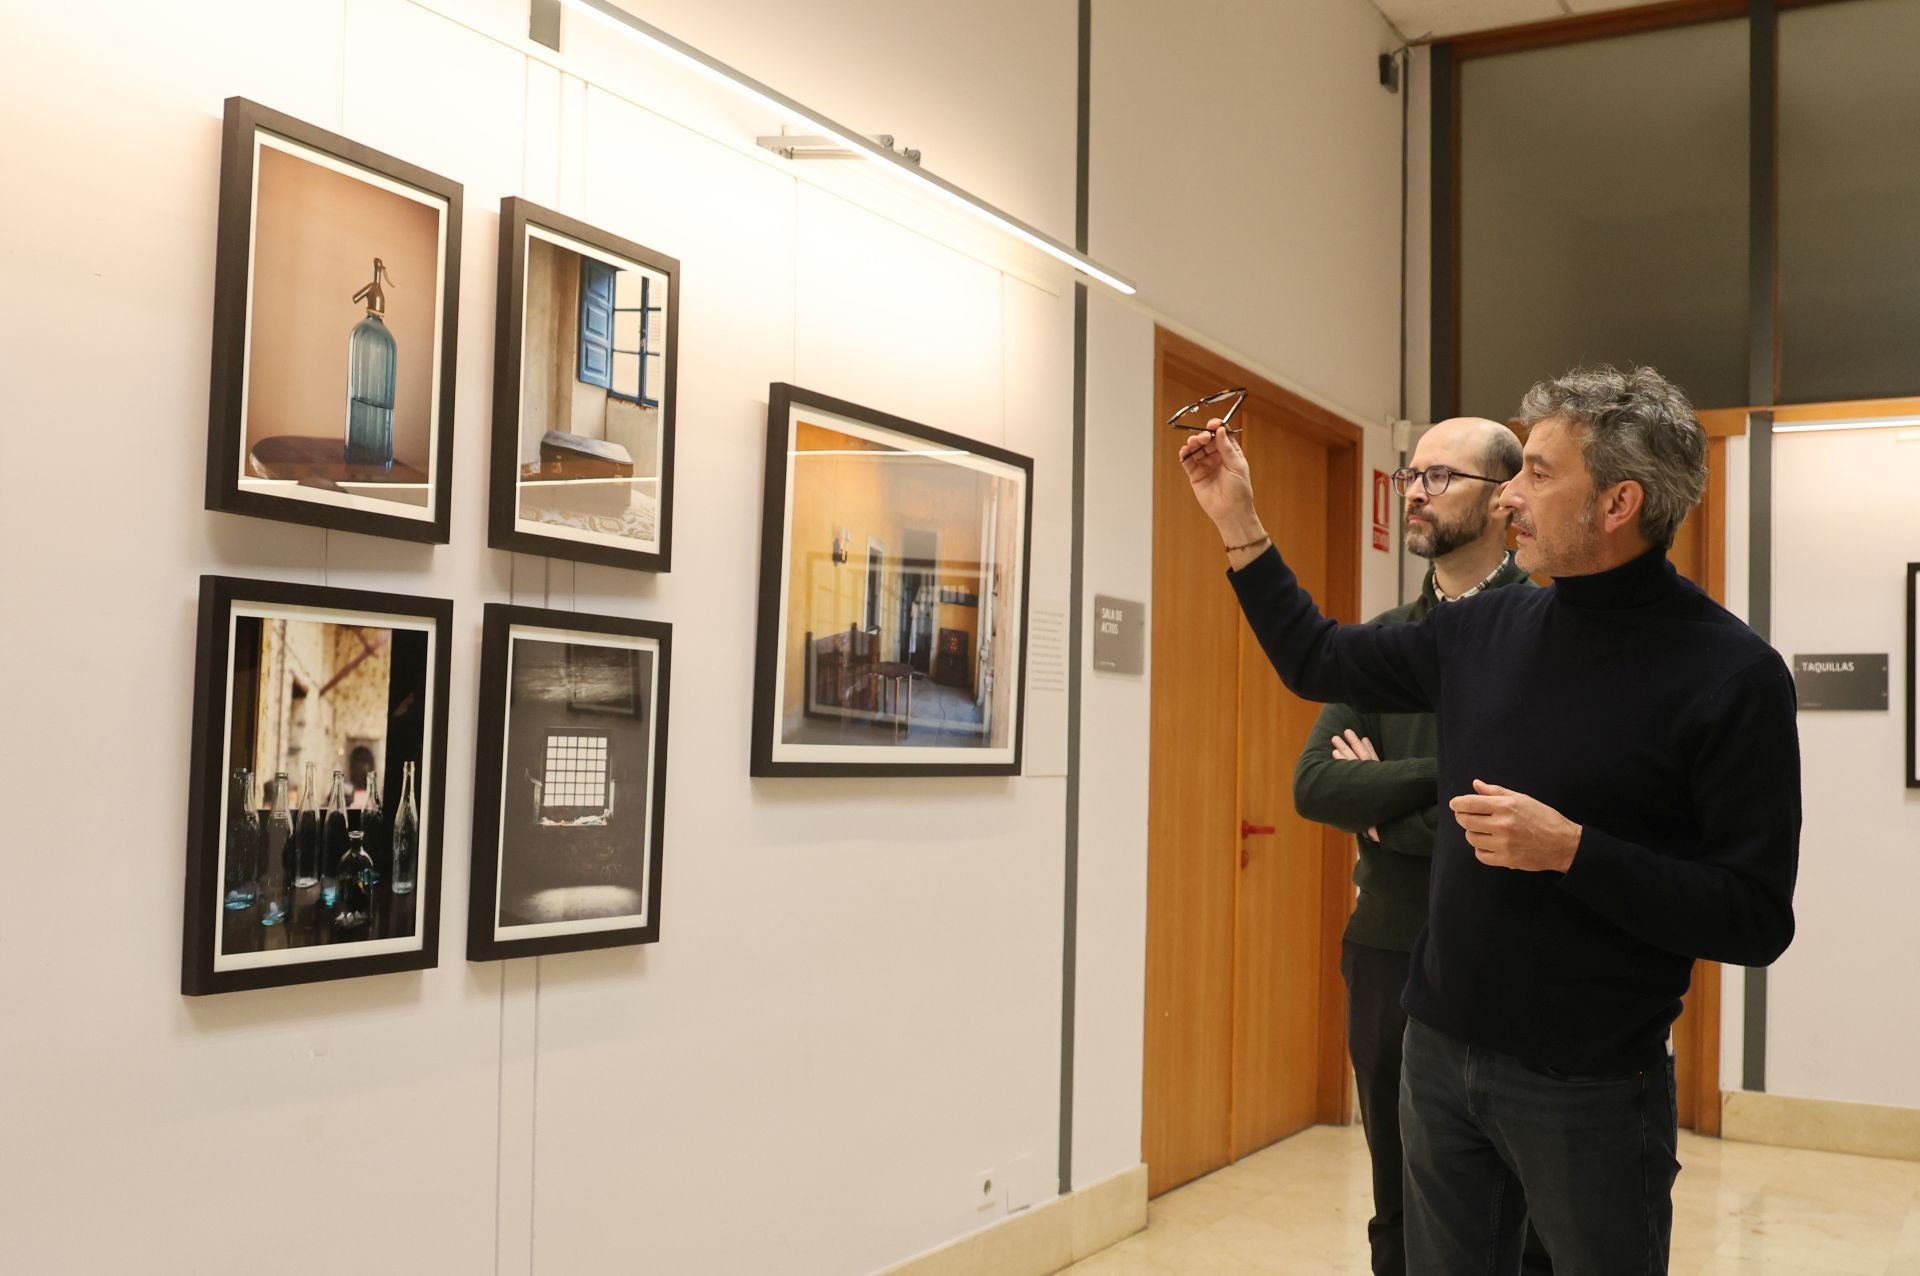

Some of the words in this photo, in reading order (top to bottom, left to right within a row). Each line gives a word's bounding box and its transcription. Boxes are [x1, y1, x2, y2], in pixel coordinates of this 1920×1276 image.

[1102, 607, 1115, 620] SALA
[1115, 609, 1122, 622] DE
[1101, 622, 1119, 634] ACTOS
[1802, 662, 1855, 673] TAQUILLAS
